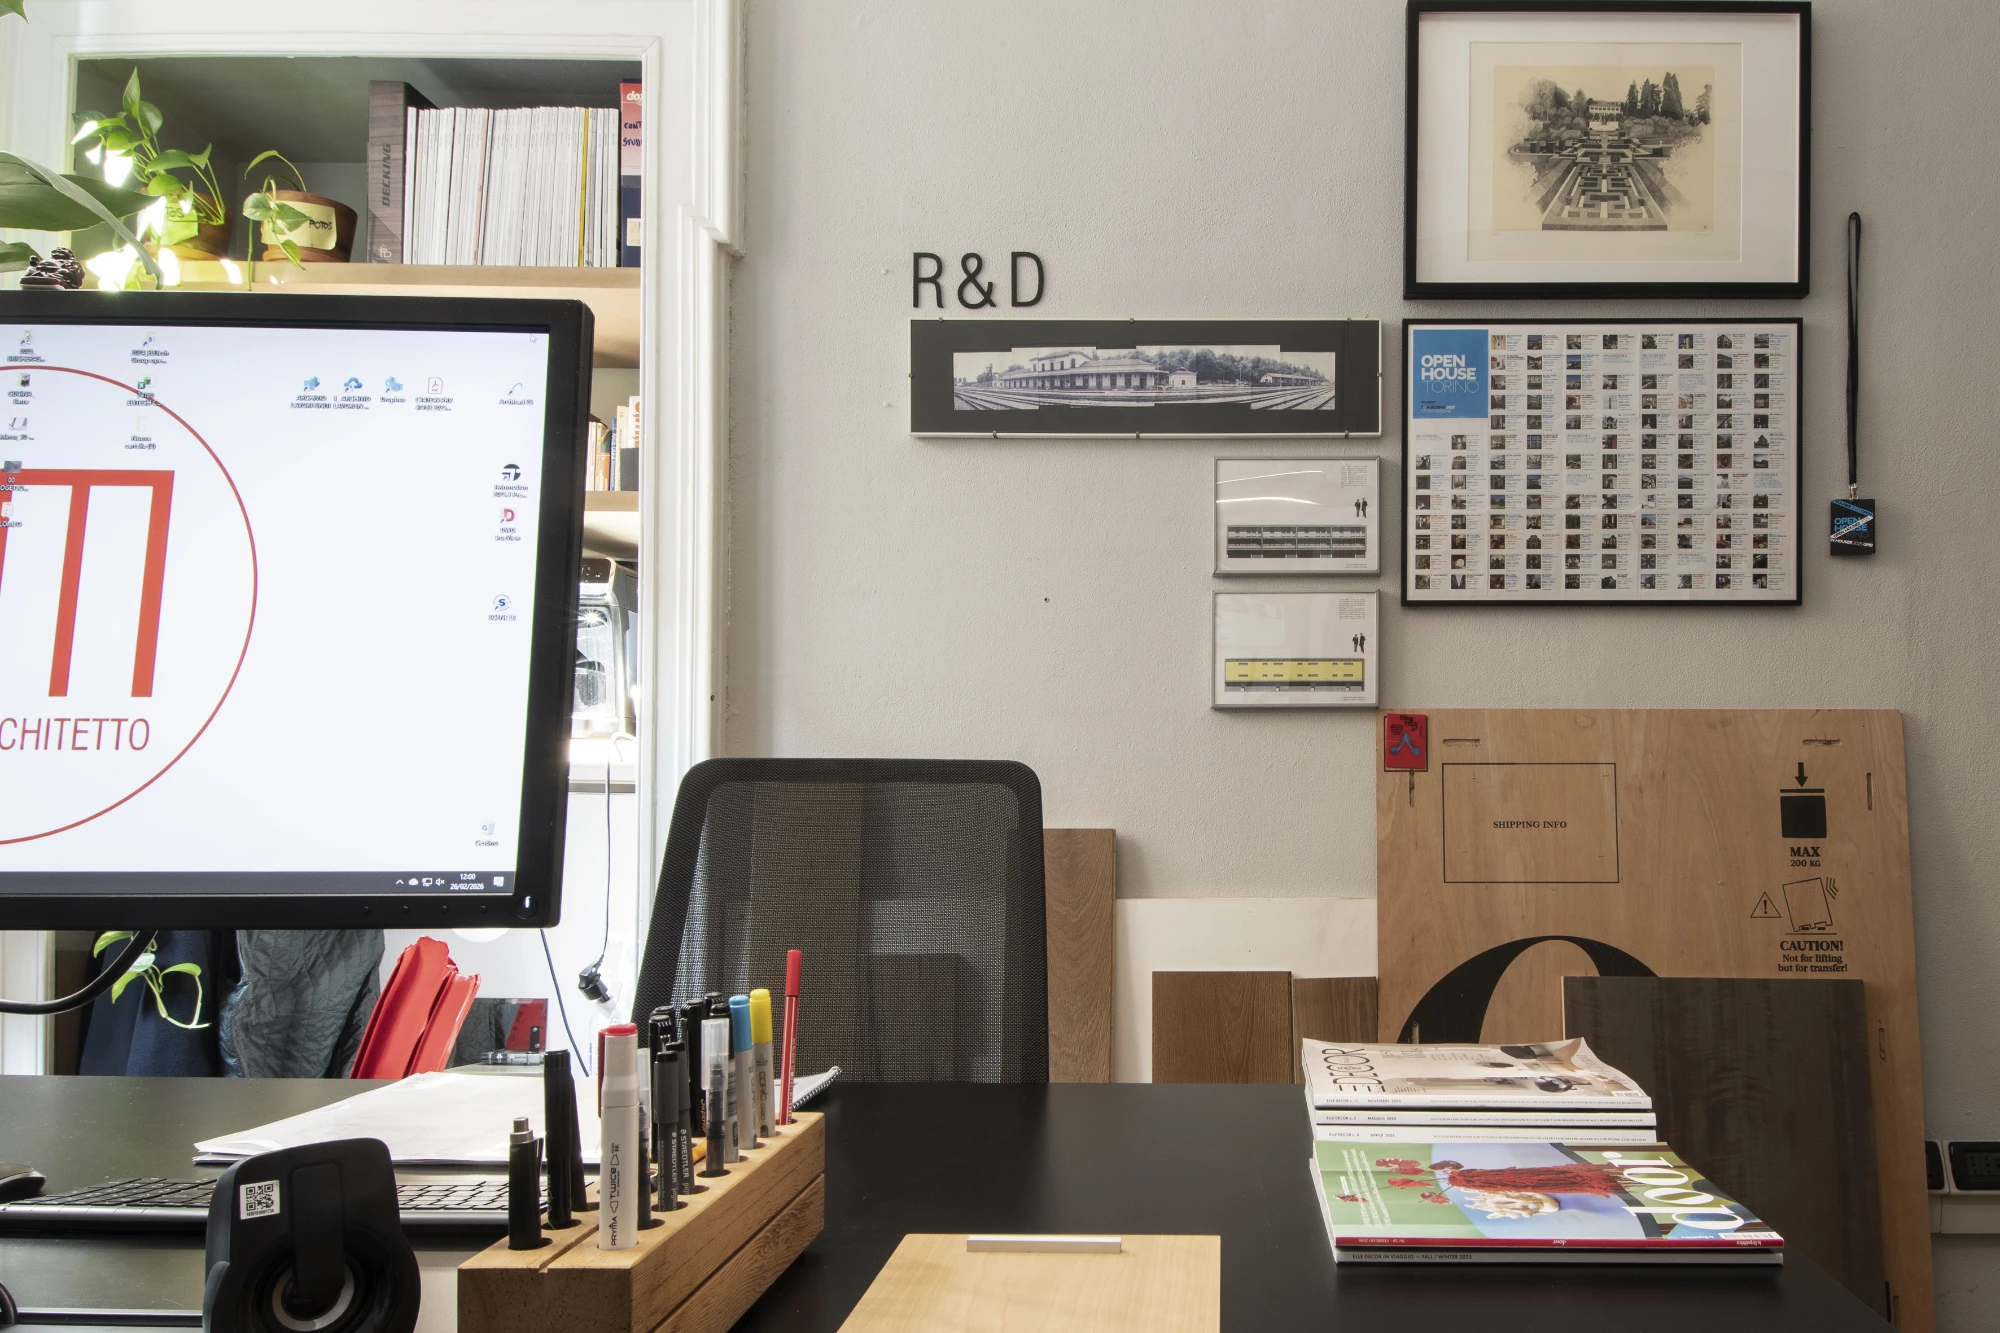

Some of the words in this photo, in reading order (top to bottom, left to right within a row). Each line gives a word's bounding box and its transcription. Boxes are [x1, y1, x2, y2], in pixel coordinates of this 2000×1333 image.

[381, 143, 392, 207] DECKING
[309, 218, 333, 231] POTOS
[1421, 355, 1465, 367] OPEN
[1421, 368, 1476, 380] HOUSE
[1422, 380, 1479, 393] TORINO
[1834, 524, 1868, 532] HOSE
[1493, 820, 1540, 829] SHIPPING
[1542, 820, 1567, 829] INFO
[1789, 846, 1821, 857] MAX
[1780, 940, 1844, 952] CAUTION!
[1782, 954, 1798, 962] Not
[1800, 954, 1813, 962] for
[1815, 954, 1843, 964] lifting
[1778, 964, 1793, 972] but
[1795, 964, 1808, 972] for
[1810, 964, 1848, 972] transfer!
[1322, 1048, 1382, 1084] DECOR
[681, 1136, 690, 1179] STAEDTLER
[609, 1215, 617, 1246] PRYMA
